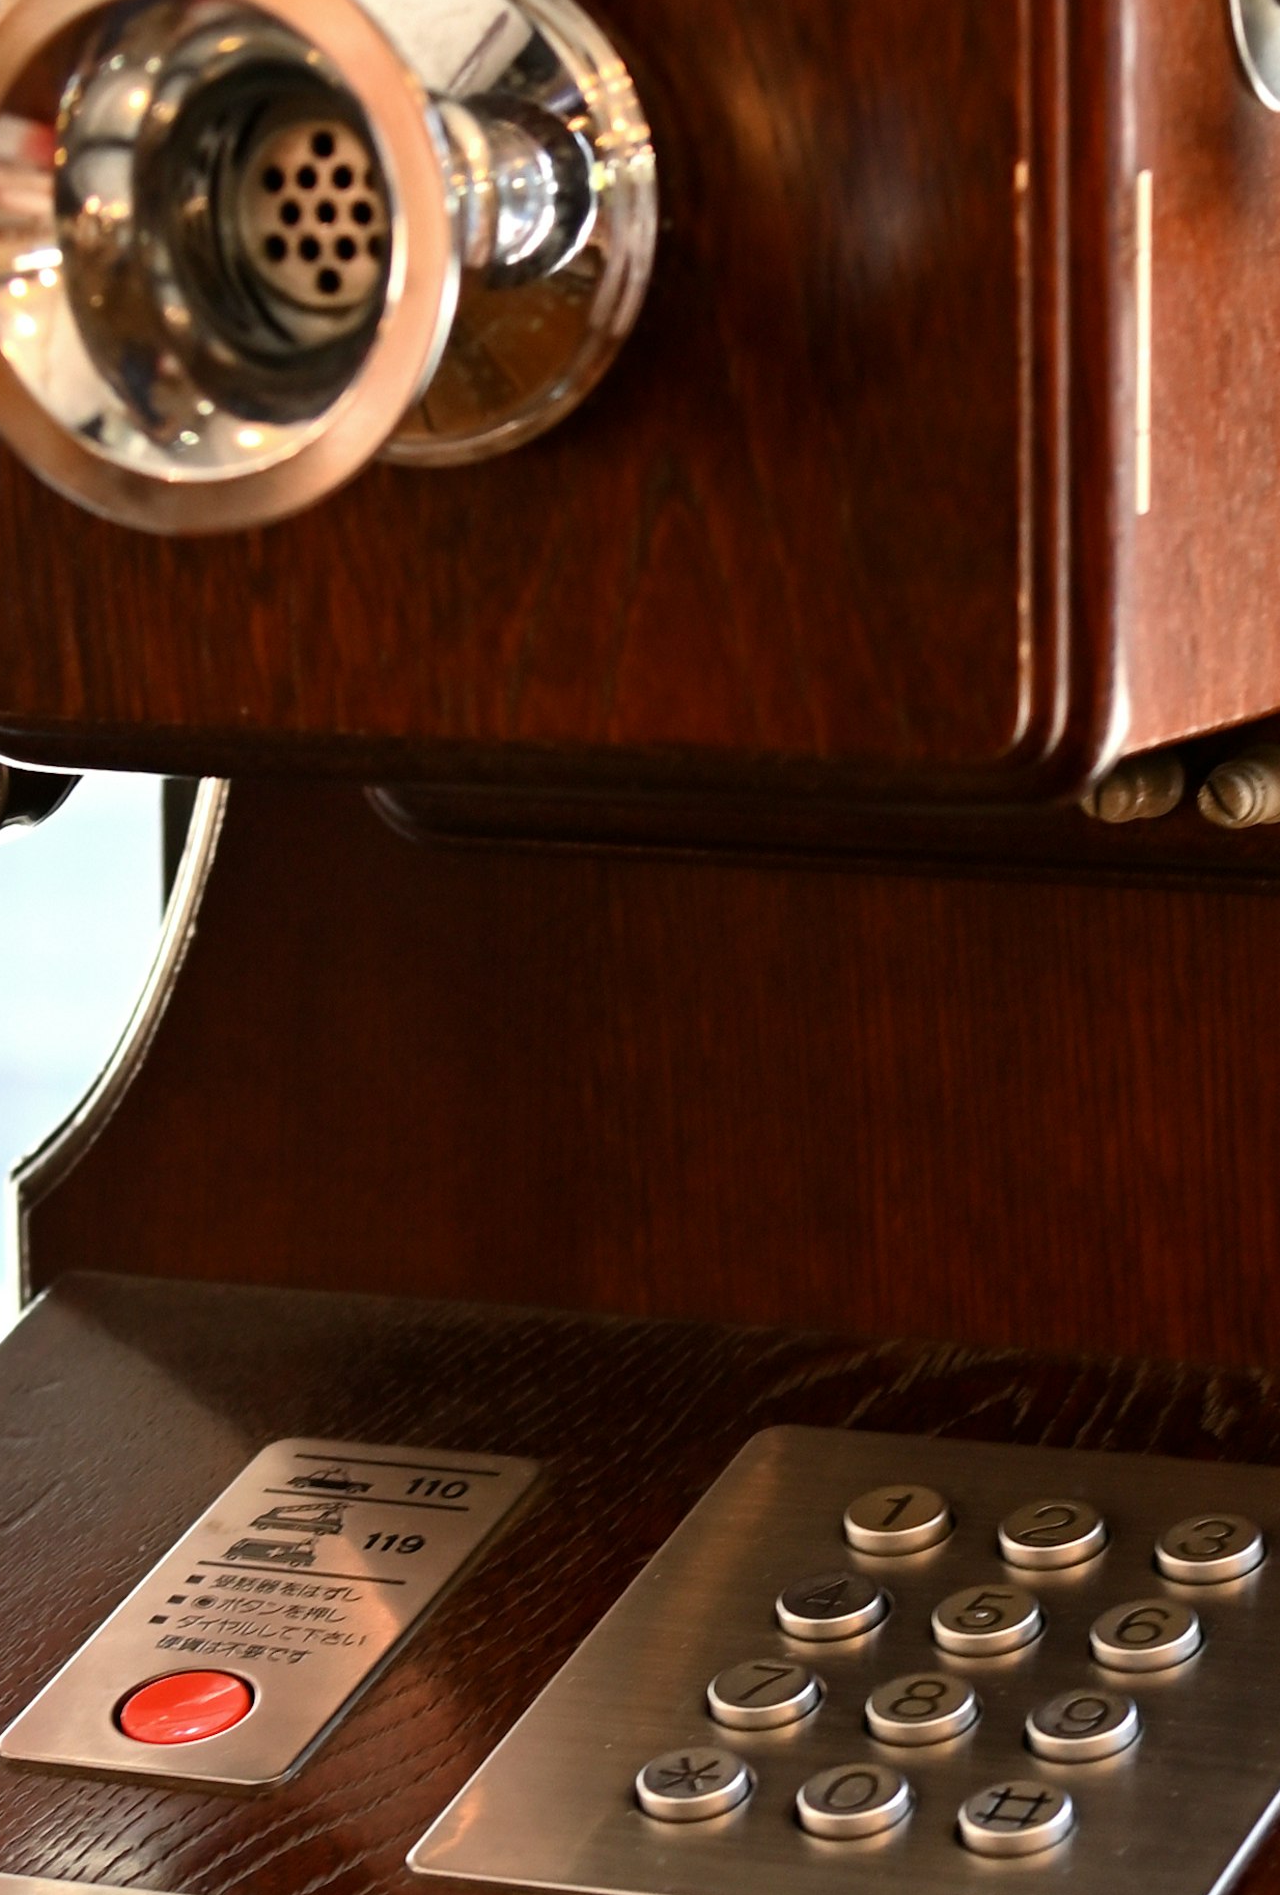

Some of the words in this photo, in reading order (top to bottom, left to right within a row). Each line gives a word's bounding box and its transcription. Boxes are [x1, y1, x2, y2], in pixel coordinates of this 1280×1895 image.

[405, 1476, 471, 1500] 110
[882, 1494, 914, 1527] 1
[1020, 1506, 1078, 1544] 2
[1177, 1519, 1236, 1556] 3
[363, 1531, 427, 1556] 119
[802, 1578, 848, 1609] 4
[955, 1592, 1013, 1630] 5
[1115, 1607, 1170, 1644] 6
[176, 1614, 368, 1648] ダイヤルして下さい
[154, 1634, 313, 1665] 硬貨は不要です
[738, 1665, 793, 1701] 7
[890, 1680, 948, 1718] 8
[1055, 1696, 1108, 1735] 9
[824, 1772, 880, 1810] 0
